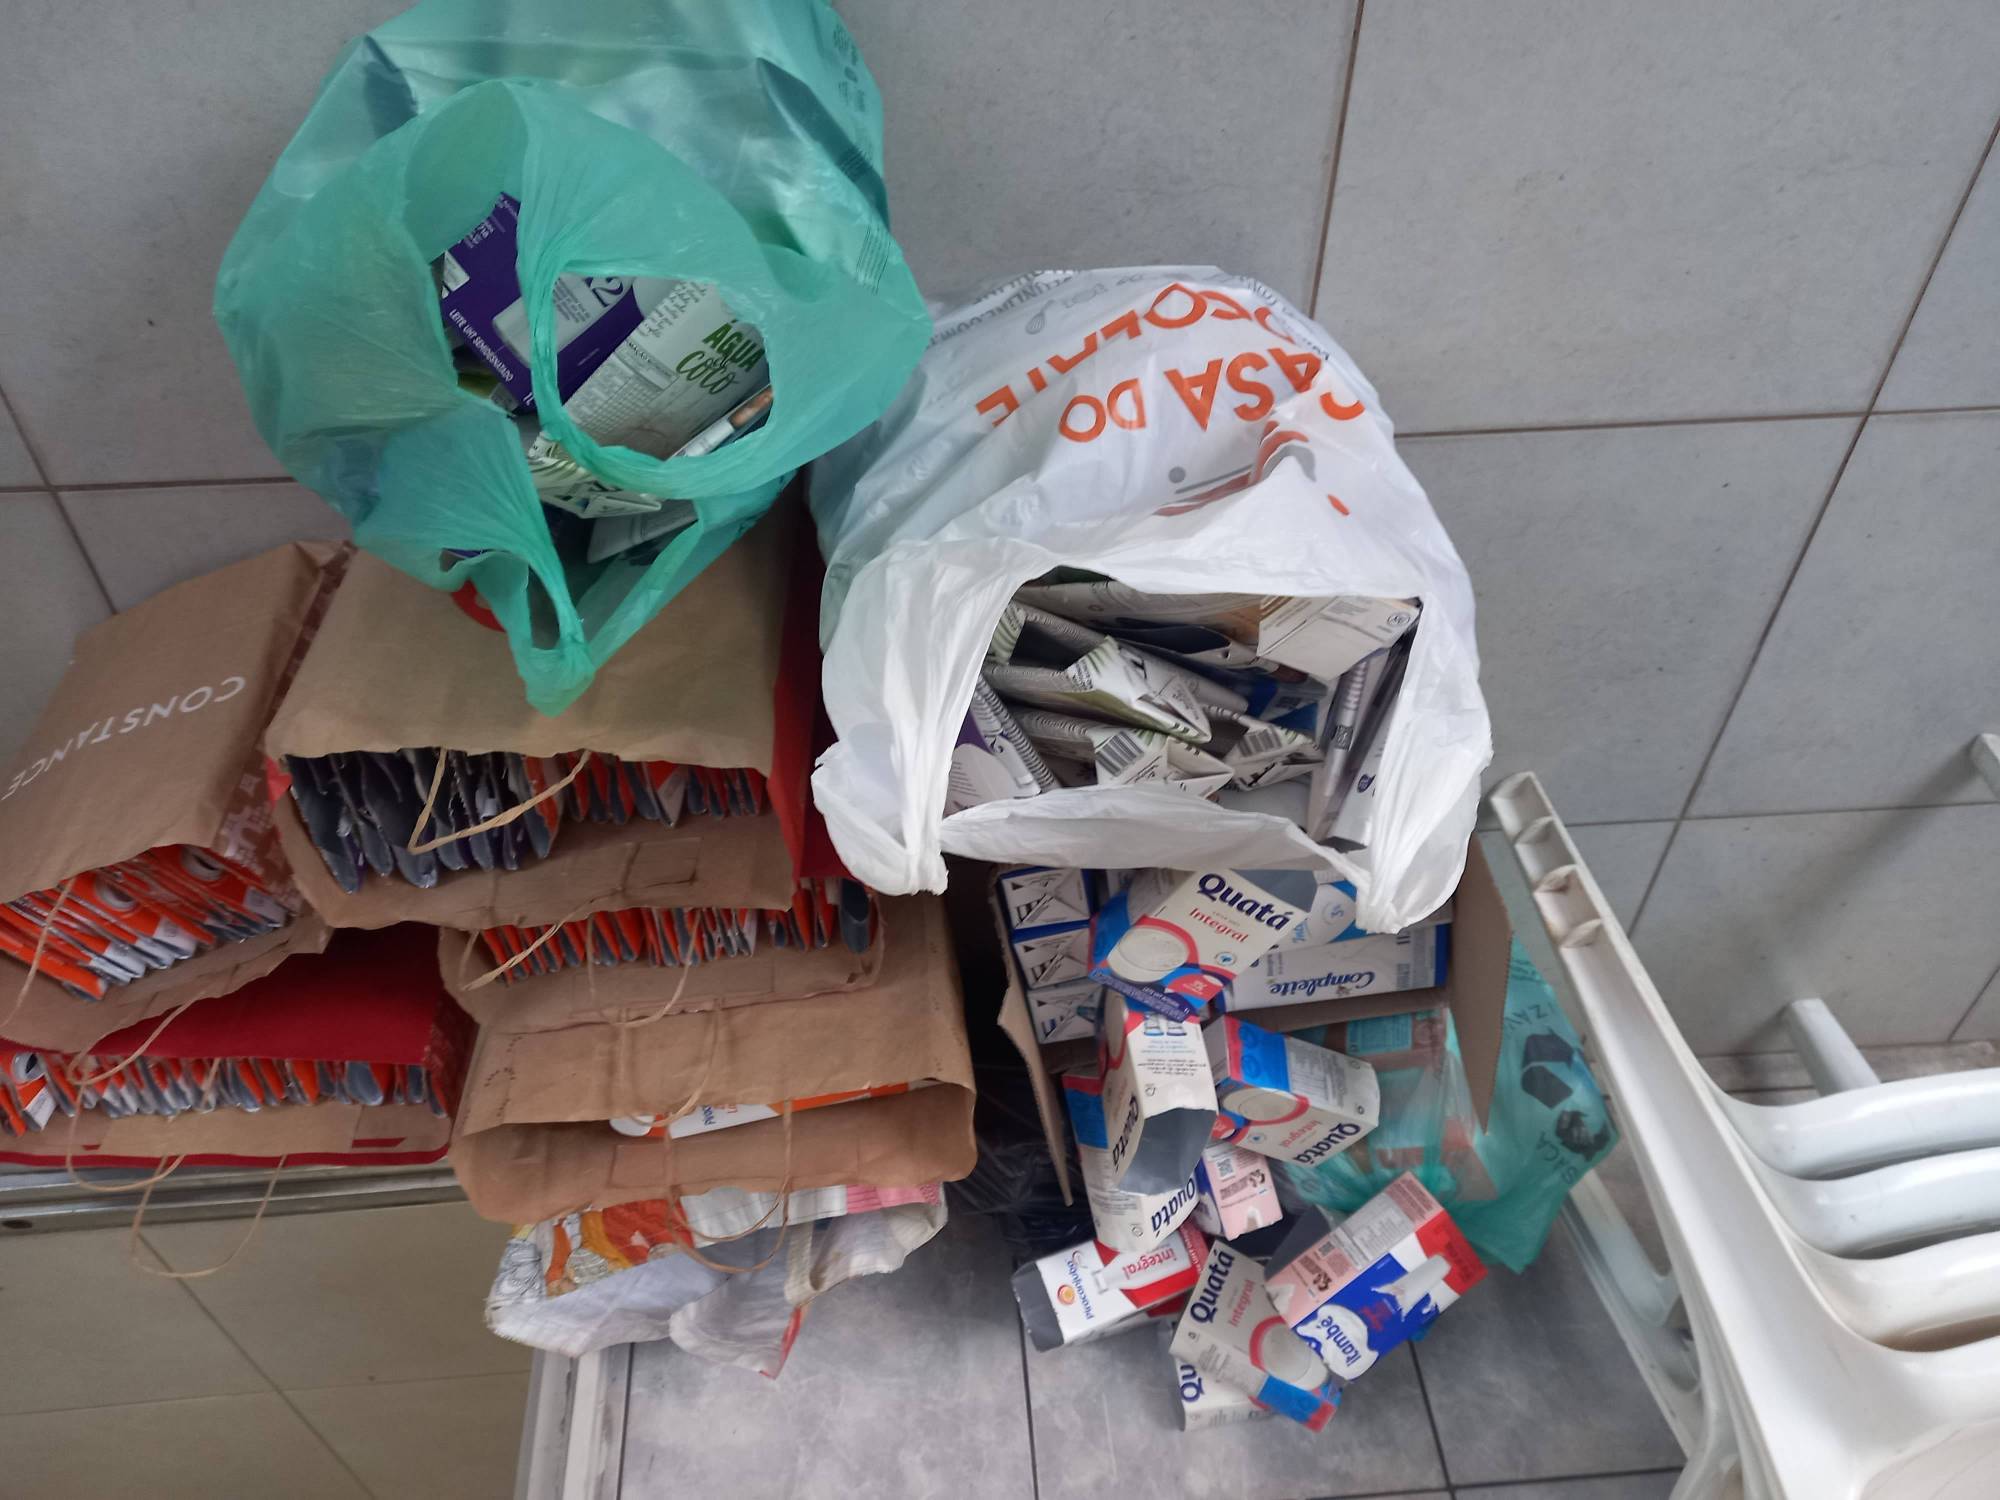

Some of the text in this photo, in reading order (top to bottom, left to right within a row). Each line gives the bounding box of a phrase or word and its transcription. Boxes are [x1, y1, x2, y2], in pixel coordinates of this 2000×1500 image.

[1059, 377, 1147, 443] DO
[0, 675, 247, 801] CONSTANCE
[1187, 906, 1250, 945] Integral
[1197, 872, 1296, 934] Quatá
[1293, 1122, 1362, 1168] Quatá
[1065, 1257, 1095, 1321] Piracanjuba
[1122, 1245, 1180, 1280] integral
[1189, 1246, 1236, 1324] Quatá
[1227, 1277, 1258, 1329] Integral
